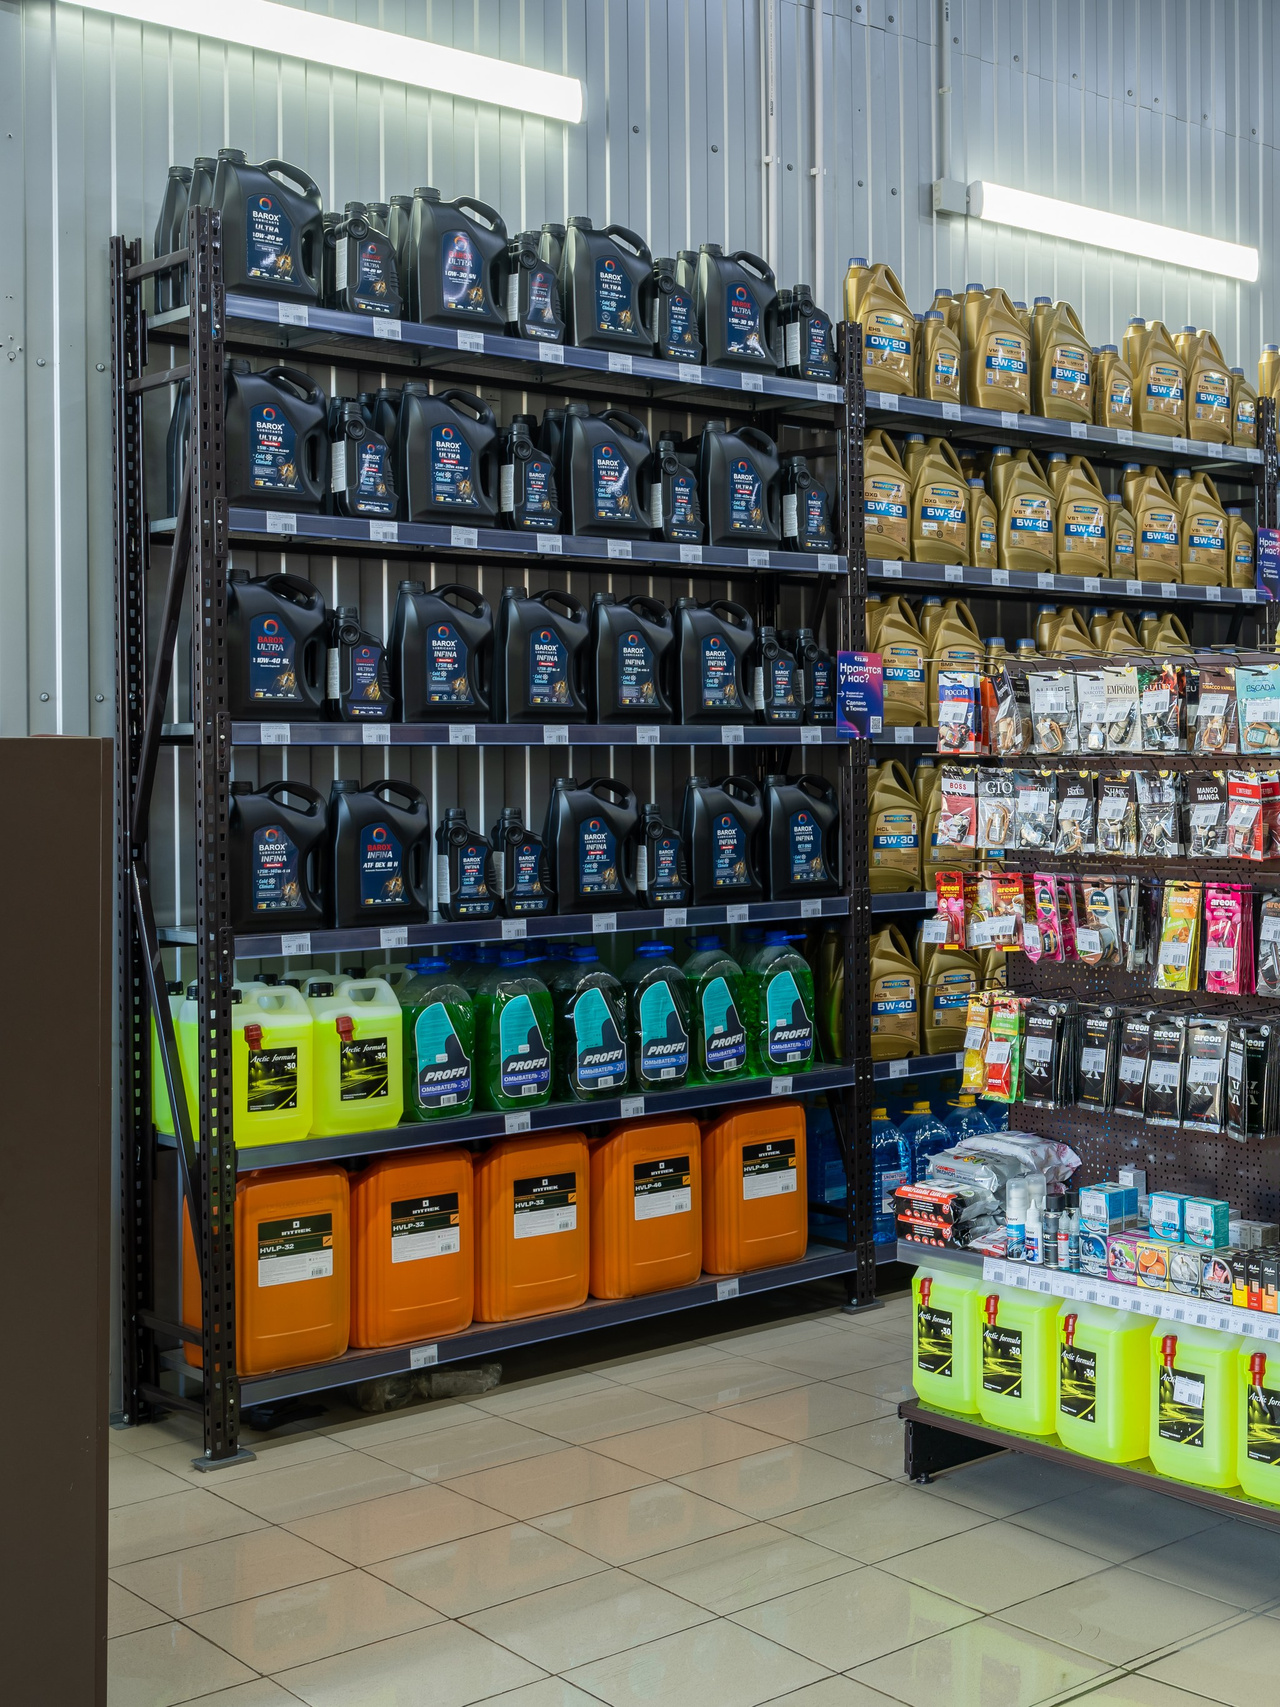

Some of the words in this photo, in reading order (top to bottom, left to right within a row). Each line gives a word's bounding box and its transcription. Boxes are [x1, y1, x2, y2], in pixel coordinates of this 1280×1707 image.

[253, 211, 279, 221] BAROX
[255, 224, 279, 233] ULTRA
[732, 308, 751, 316] ULTRA
[992, 358, 1024, 370] 5W-30
[1152, 386, 1180, 395] 5W-30
[1200, 394, 1227, 404] 5W-30
[257, 422, 282, 431] BAROX
[259, 434, 282, 442] ULTRA
[597, 460, 618, 468] BAROX
[867, 502, 902, 514] 5W-30
[927, 508, 961, 519] 5W-30
[1016, 519, 1048, 528] 5W-40
[1147, 532, 1175, 541] 5W-40
[1265, 546, 1280, 556] нас?
[257, 643, 283, 652] ULTRA
[840, 663, 881, 673] Нравится
[840, 675, 844, 684] у
[848, 674, 869, 683] нас?
[1246, 683, 1276, 692] ESCADA
[949, 782, 967, 790] BOSS
[986, 781, 1012, 794] GIO
[584, 833, 606, 841] BAROX
[879, 836, 914, 844] 5W-30
[261, 855, 287, 863] INFINA
[1210, 899, 1235, 907] areon
[877, 1001, 912, 1010] 5W-40
[1029, 1017, 1052, 1026] areon
[774, 1027, 810, 1041] PROFFI
[341, 1044, 362, 1055] Arctic
[647, 1042, 686, 1055] PROFFI
[375, 1052, 387, 1060] -30
[583, 1049, 623, 1064] PROFFI
[424, 1066, 467, 1082] PROFFI
[580, 1065, 614, 1074] ОМЫВАТЕЛЬ
[421, 1082, 458, 1093] ОМЫВАТЕЛЬ
[635, 1182, 662, 1191] HVLP-46
[260, 1242, 295, 1254] HVLP-32
[1248, 1392, 1267, 1405] Arctic
